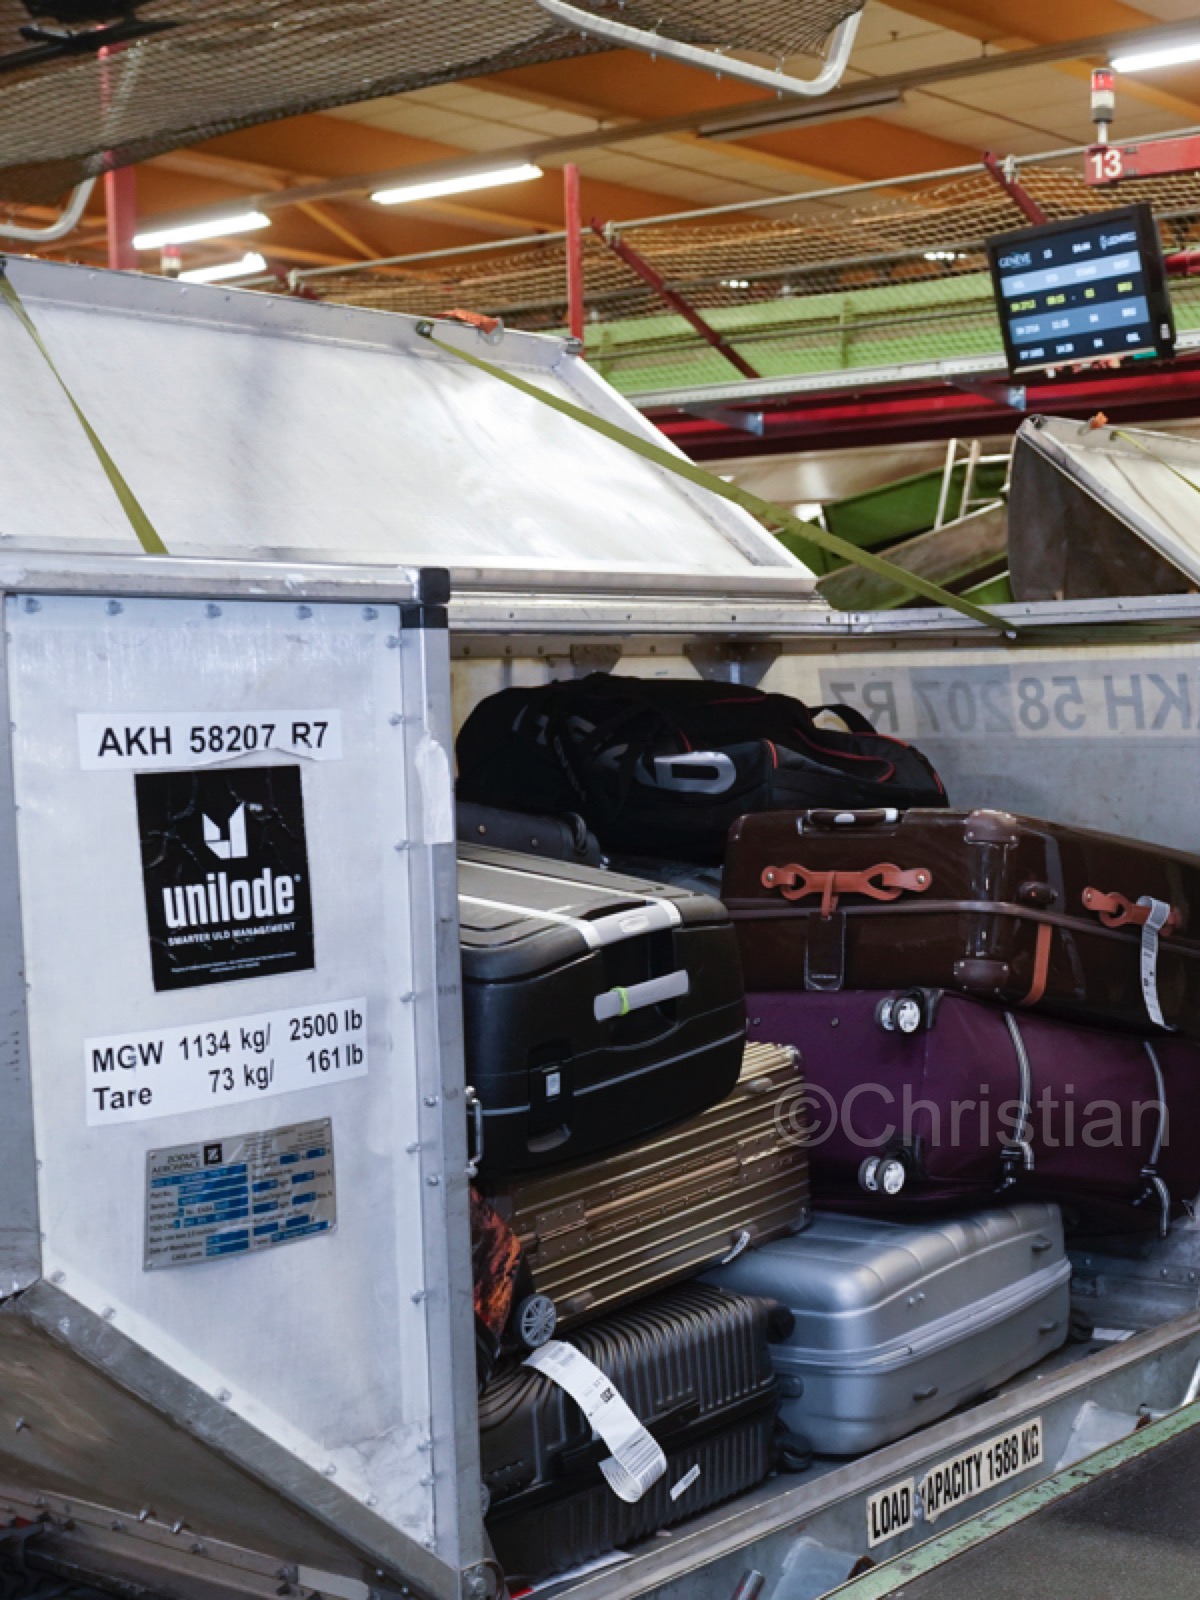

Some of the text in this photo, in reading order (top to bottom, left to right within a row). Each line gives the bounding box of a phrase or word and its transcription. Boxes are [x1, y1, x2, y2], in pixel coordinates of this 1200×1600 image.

[1090, 149, 1122, 179] 13
[98, 722, 329, 757] AKH 58207 R7
[162, 868, 294, 928] unilode
[168, 921, 296, 946] SMARTER ULD MANAGEMENT
[92, 1009, 363, 1073] MGW 1134 kg/ 2500 lb
[93, 1045, 364, 1112] Tare 73 kg/ 161 lb
[872, 1424, 1039, 1539] LOAD APACITY 1588 KG
